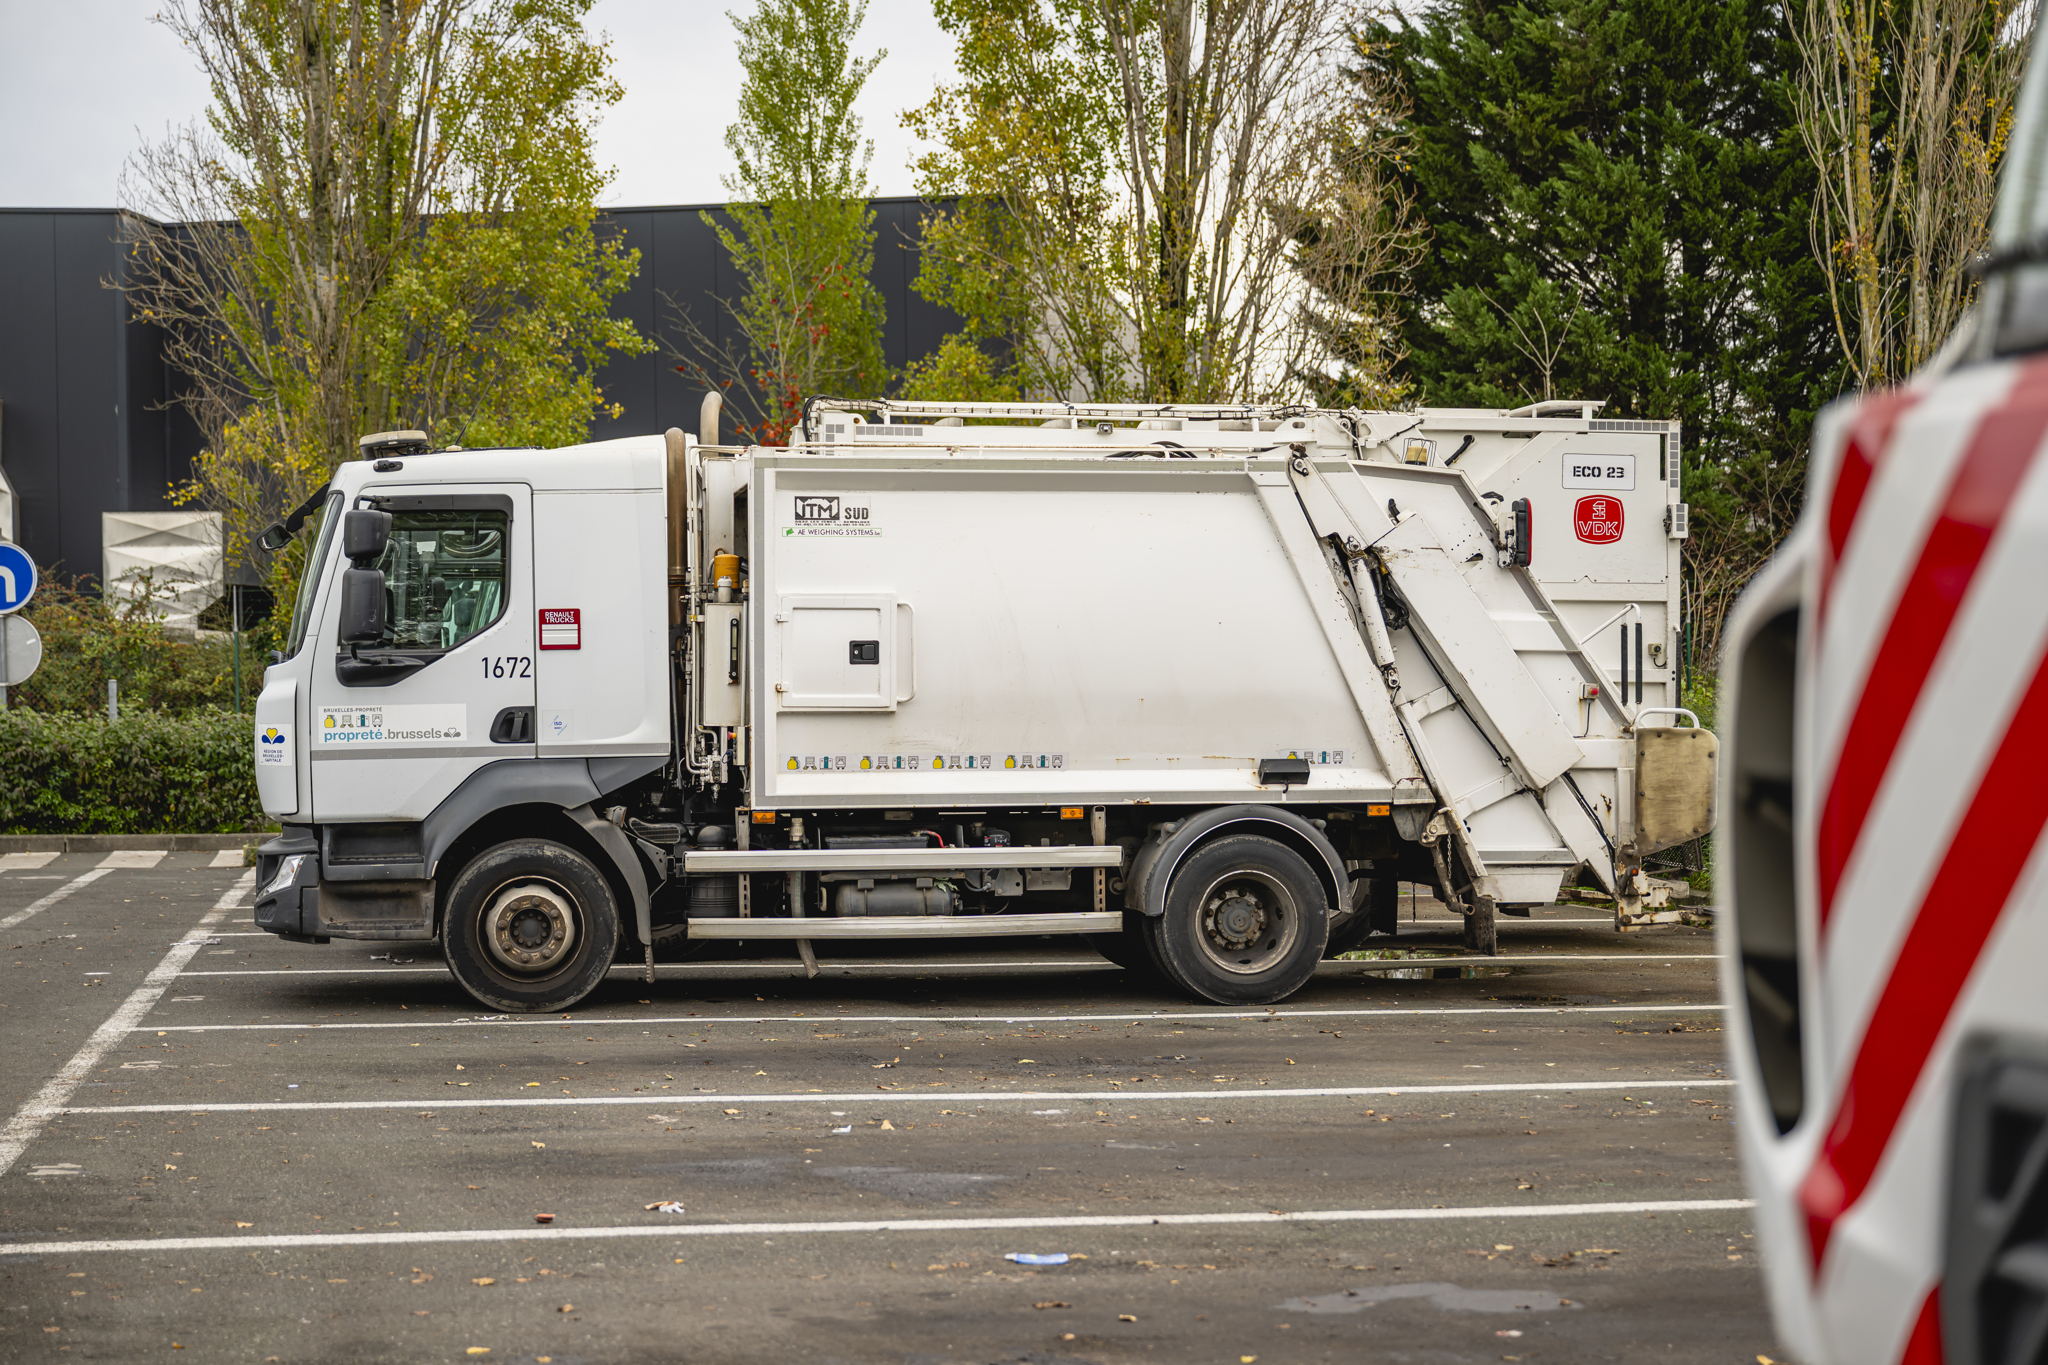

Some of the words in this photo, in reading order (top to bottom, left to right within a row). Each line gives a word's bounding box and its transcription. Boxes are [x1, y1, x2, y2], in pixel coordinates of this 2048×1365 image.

[1573, 465, 1601, 478] ECO
[1606, 466, 1625, 479] 23
[844, 507, 869, 520] SUD
[1579, 521, 1618, 536] VDK
[481, 656, 531, 679] 1672
